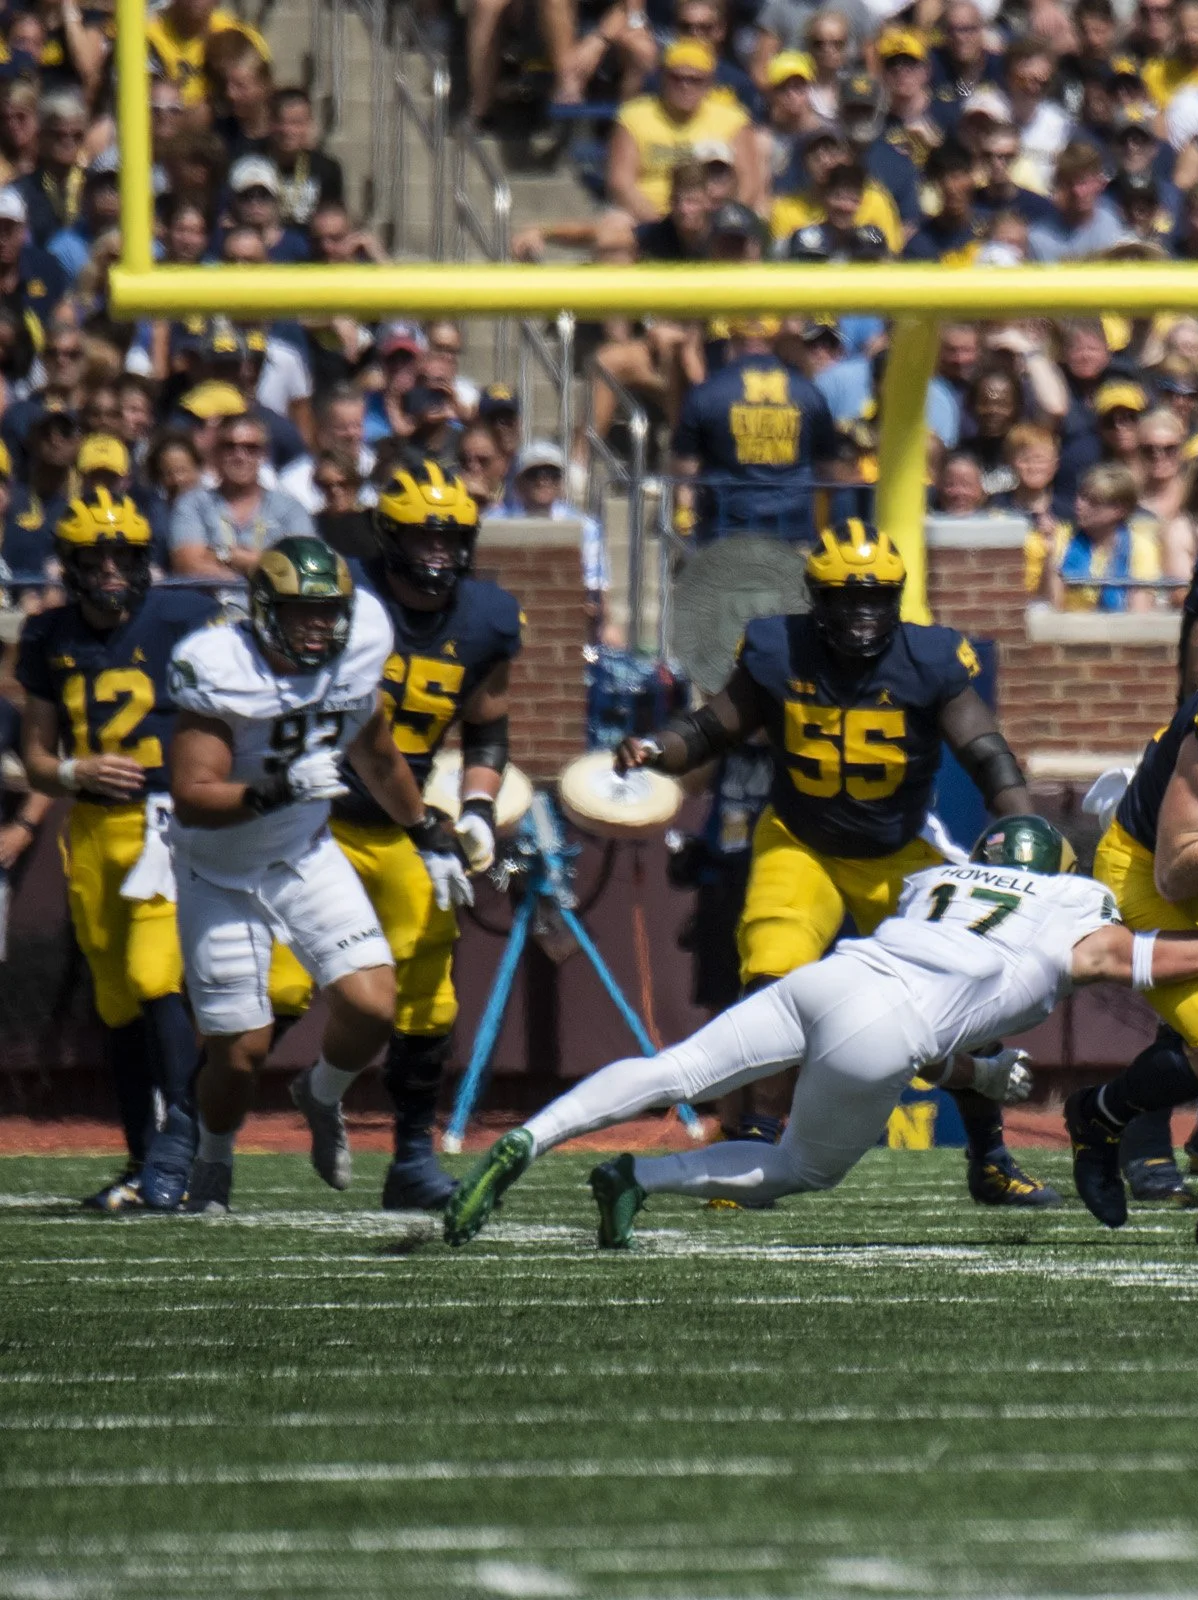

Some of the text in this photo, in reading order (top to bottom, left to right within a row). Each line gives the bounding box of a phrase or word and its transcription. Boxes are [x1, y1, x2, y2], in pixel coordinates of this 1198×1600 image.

[62, 667, 164, 768] 12
[784, 699, 907, 800] 55
[926, 882, 1022, 935] 17
[940, 868, 1037, 895] HOWELL
